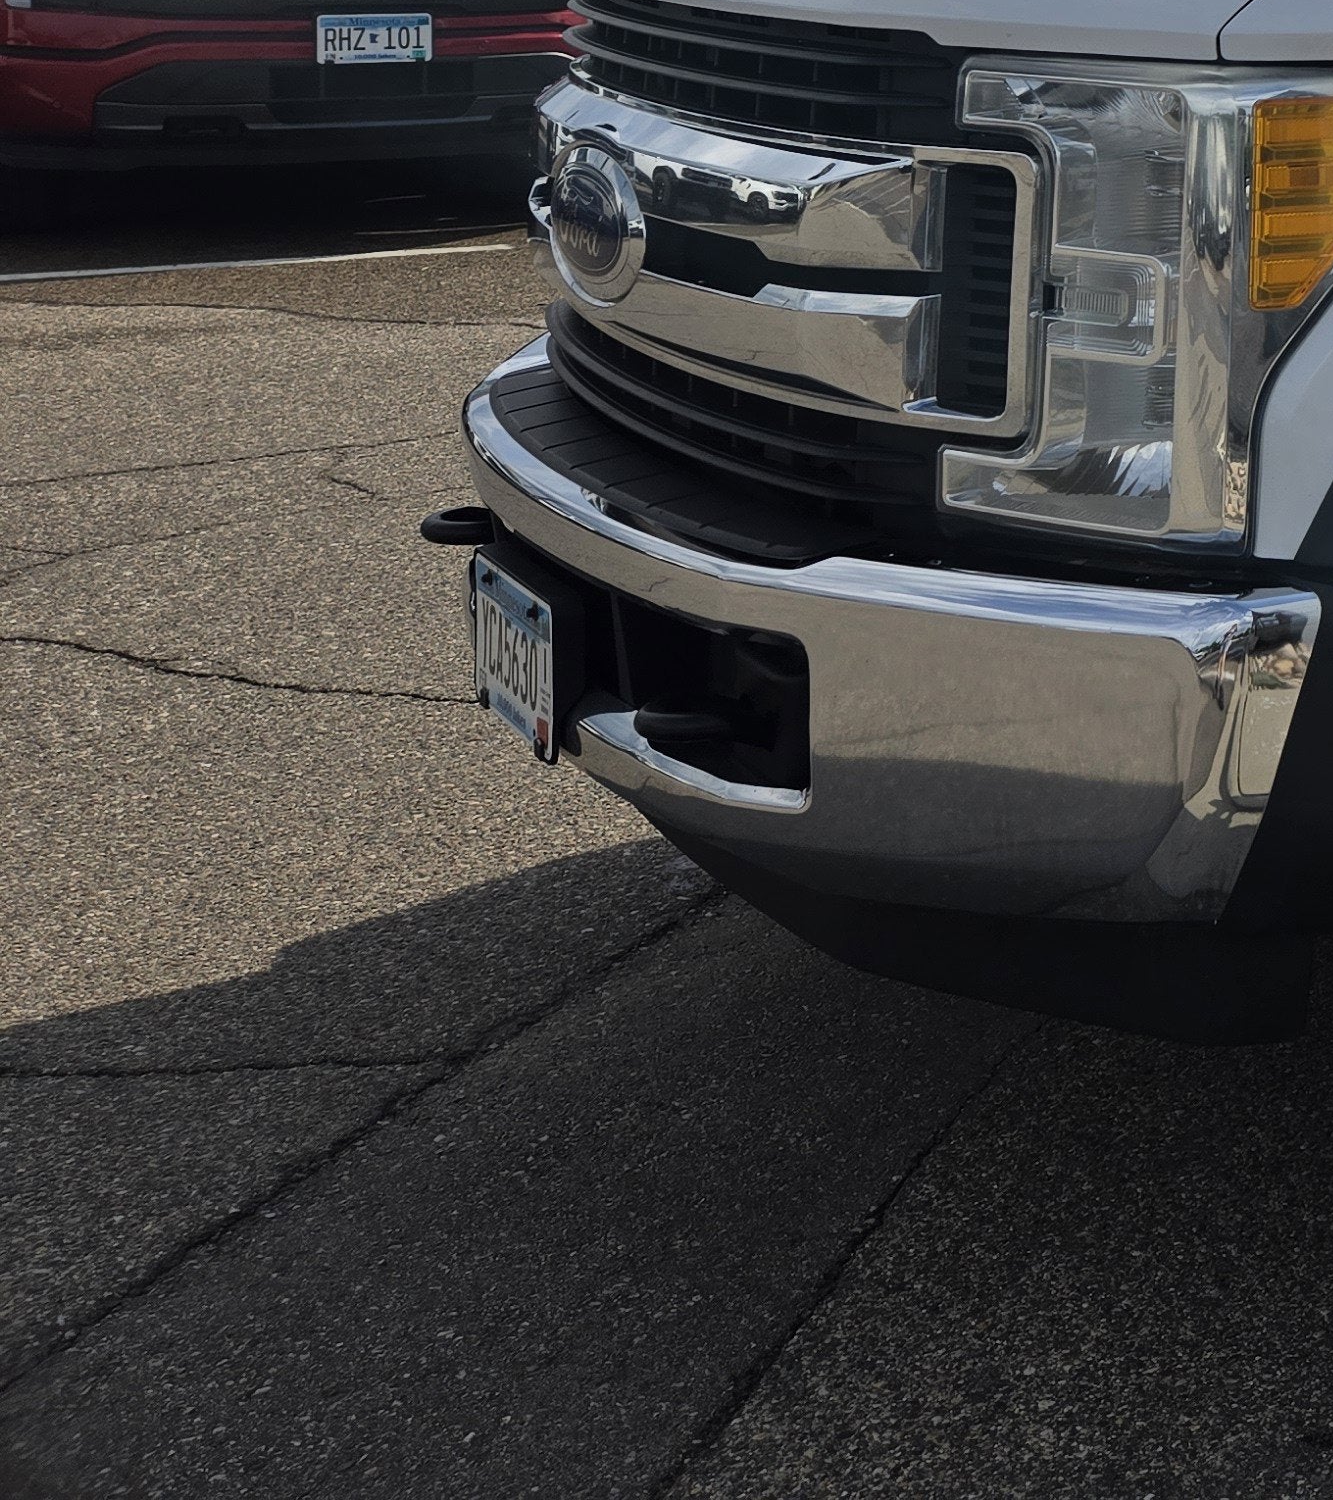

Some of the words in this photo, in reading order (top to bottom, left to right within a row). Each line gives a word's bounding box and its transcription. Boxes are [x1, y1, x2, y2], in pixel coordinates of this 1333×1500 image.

[324, 27, 366, 51] RHZ
[384, 26, 425, 50] 101
[481, 596, 538, 712] YCA5630
